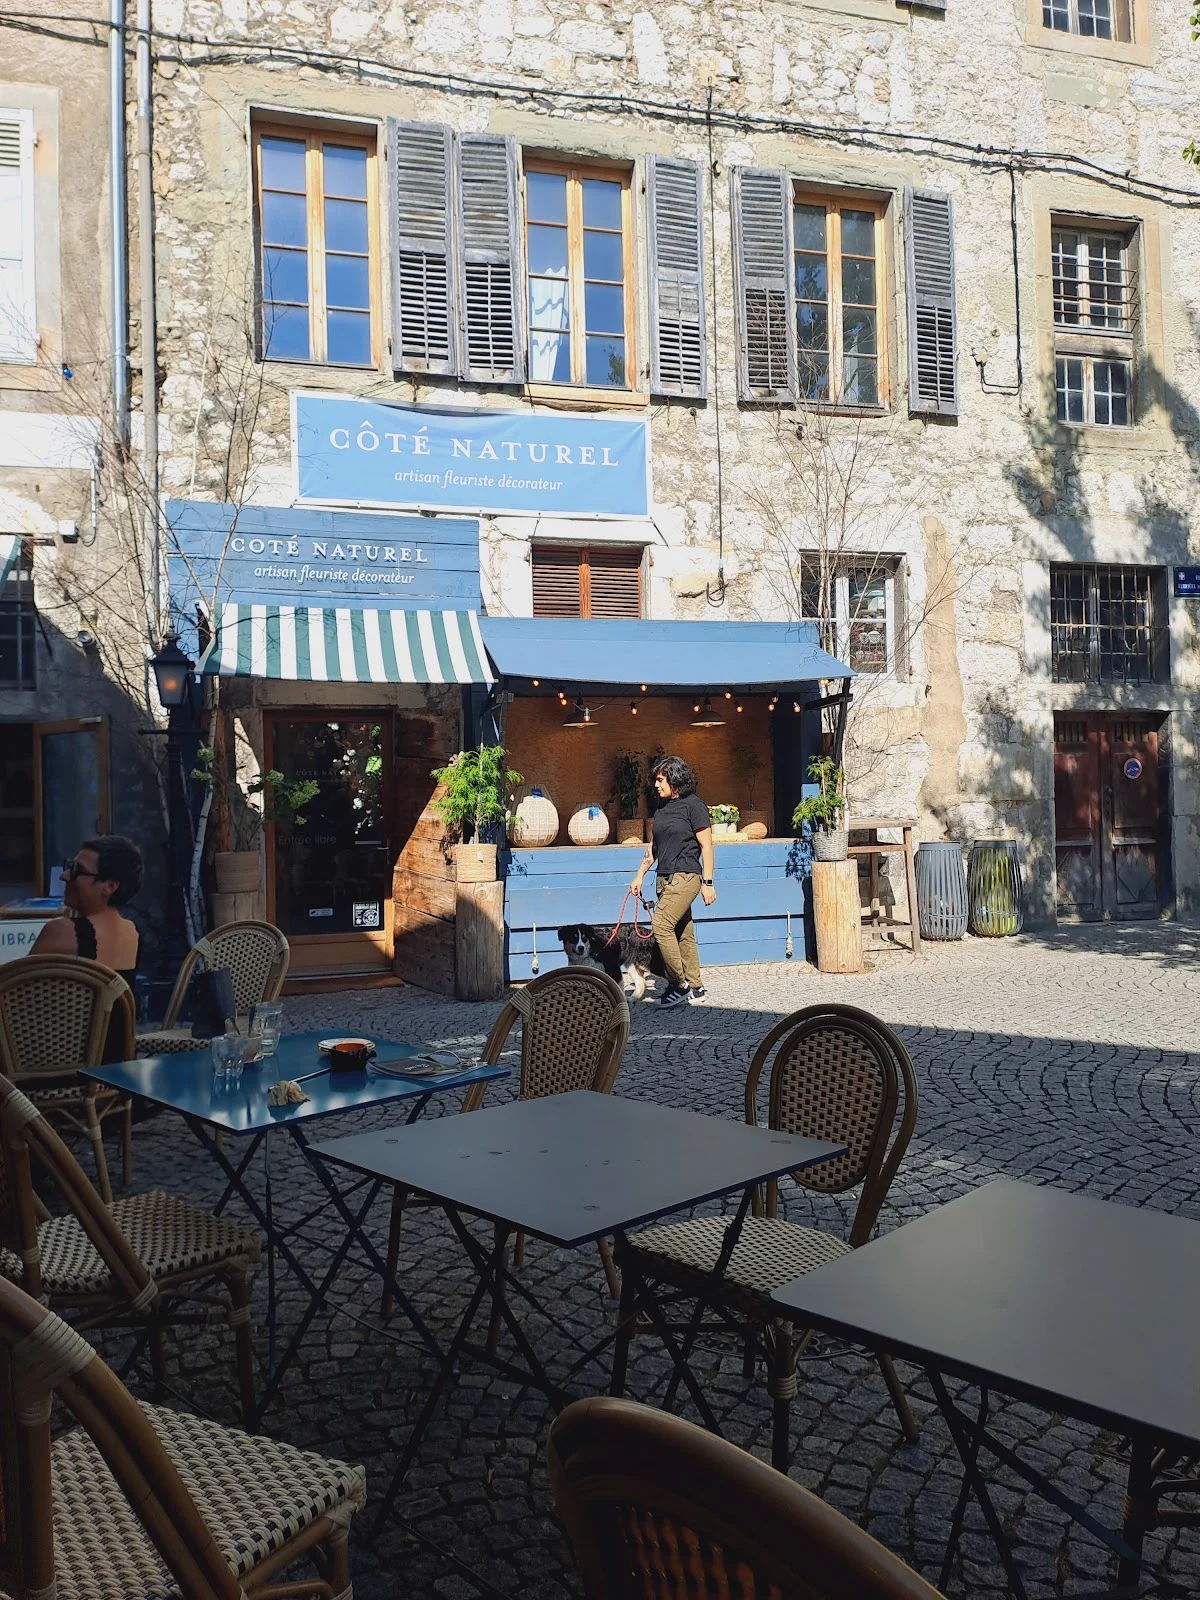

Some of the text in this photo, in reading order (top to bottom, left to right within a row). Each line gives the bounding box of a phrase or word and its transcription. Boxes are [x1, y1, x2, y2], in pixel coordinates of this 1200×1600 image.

[329, 420, 619, 466] CÔTÉ NATUREL
[394, 469, 563, 490] artisan fleuriste décorateur
[230, 534, 428, 562] COTÉ NATUREL
[254, 564, 415, 584] artisan fleuriste décorateur
[314, 834, 337, 845] libre
